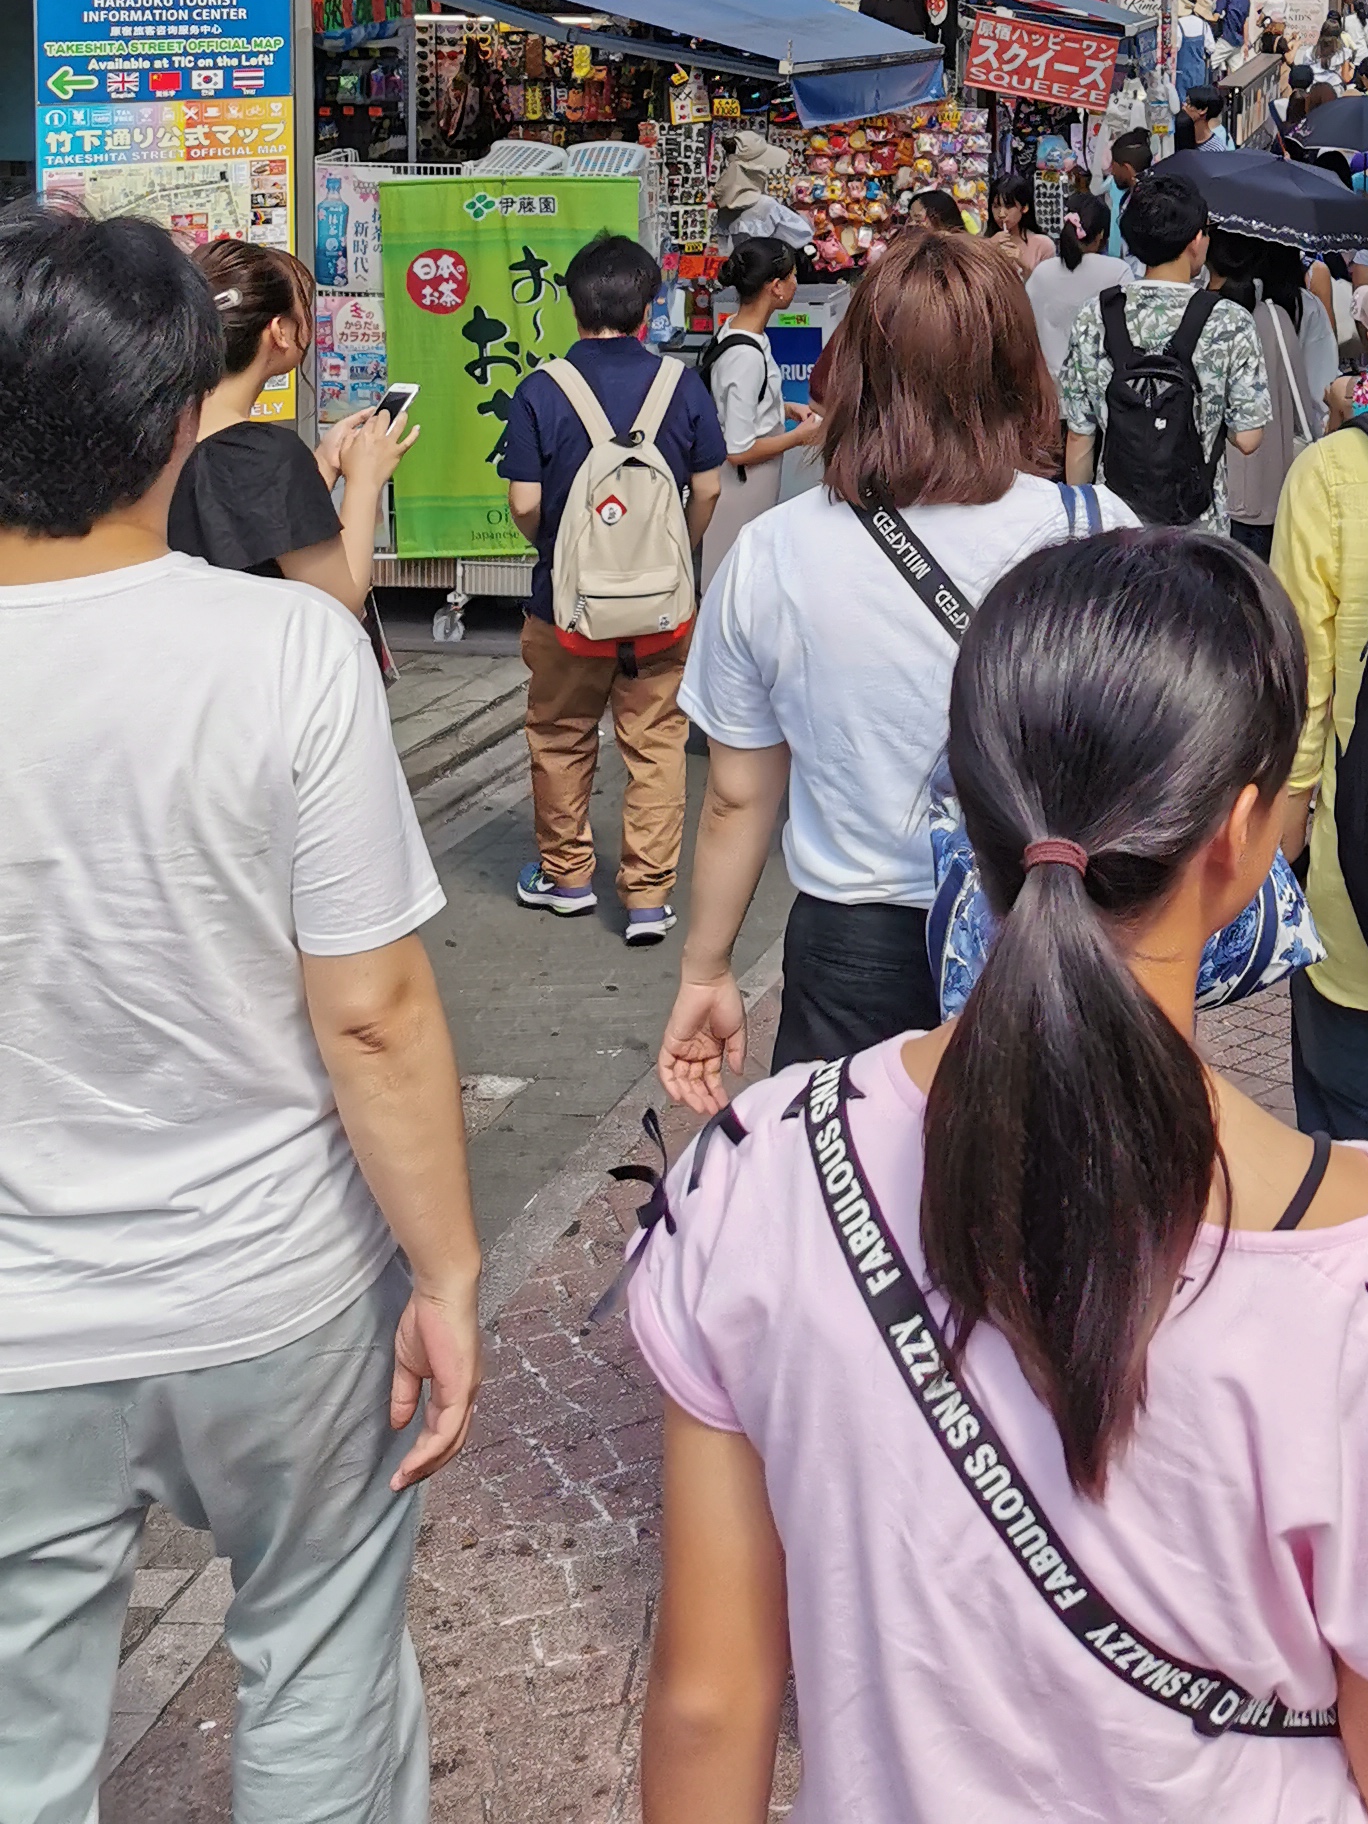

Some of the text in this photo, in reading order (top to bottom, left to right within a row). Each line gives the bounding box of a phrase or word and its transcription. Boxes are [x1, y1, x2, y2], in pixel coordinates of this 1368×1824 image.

[83, 8, 247, 23] INFORMATION CENTER
[46, 37, 284, 56] TAKESHITA STREET OFFICIAL MAP
[976, 19, 1117, 57] 原宿ハッピーワン
[88, 54, 274, 71] Available at TIC on the Left!
[972, 37, 1115, 91] スクイーズ
[968, 66, 1107, 105] SQUEEZE
[45, 144, 287, 166] TAKESHITA STREET OFFICIAL MAP
[46, 120, 287, 154] 竹下通り公式マップ
[498, 196, 556, 215] 伊藤園
[353, 220, 370, 283] 新時代へ
[412, 253, 465, 281] 日本の
[350, 301, 375, 320] 冬の
[421, 280, 462, 308] お茶
[872, 506, 933, 581] MILKFED.
[933, 583, 977, 634] KFED.
[809, 1056, 902, 1298] FABULOUS SNA
[889, 1314, 1088, 1611] FABULOUS SNAZZY
[1084, 1622, 1193, 1698] SNAZZY
